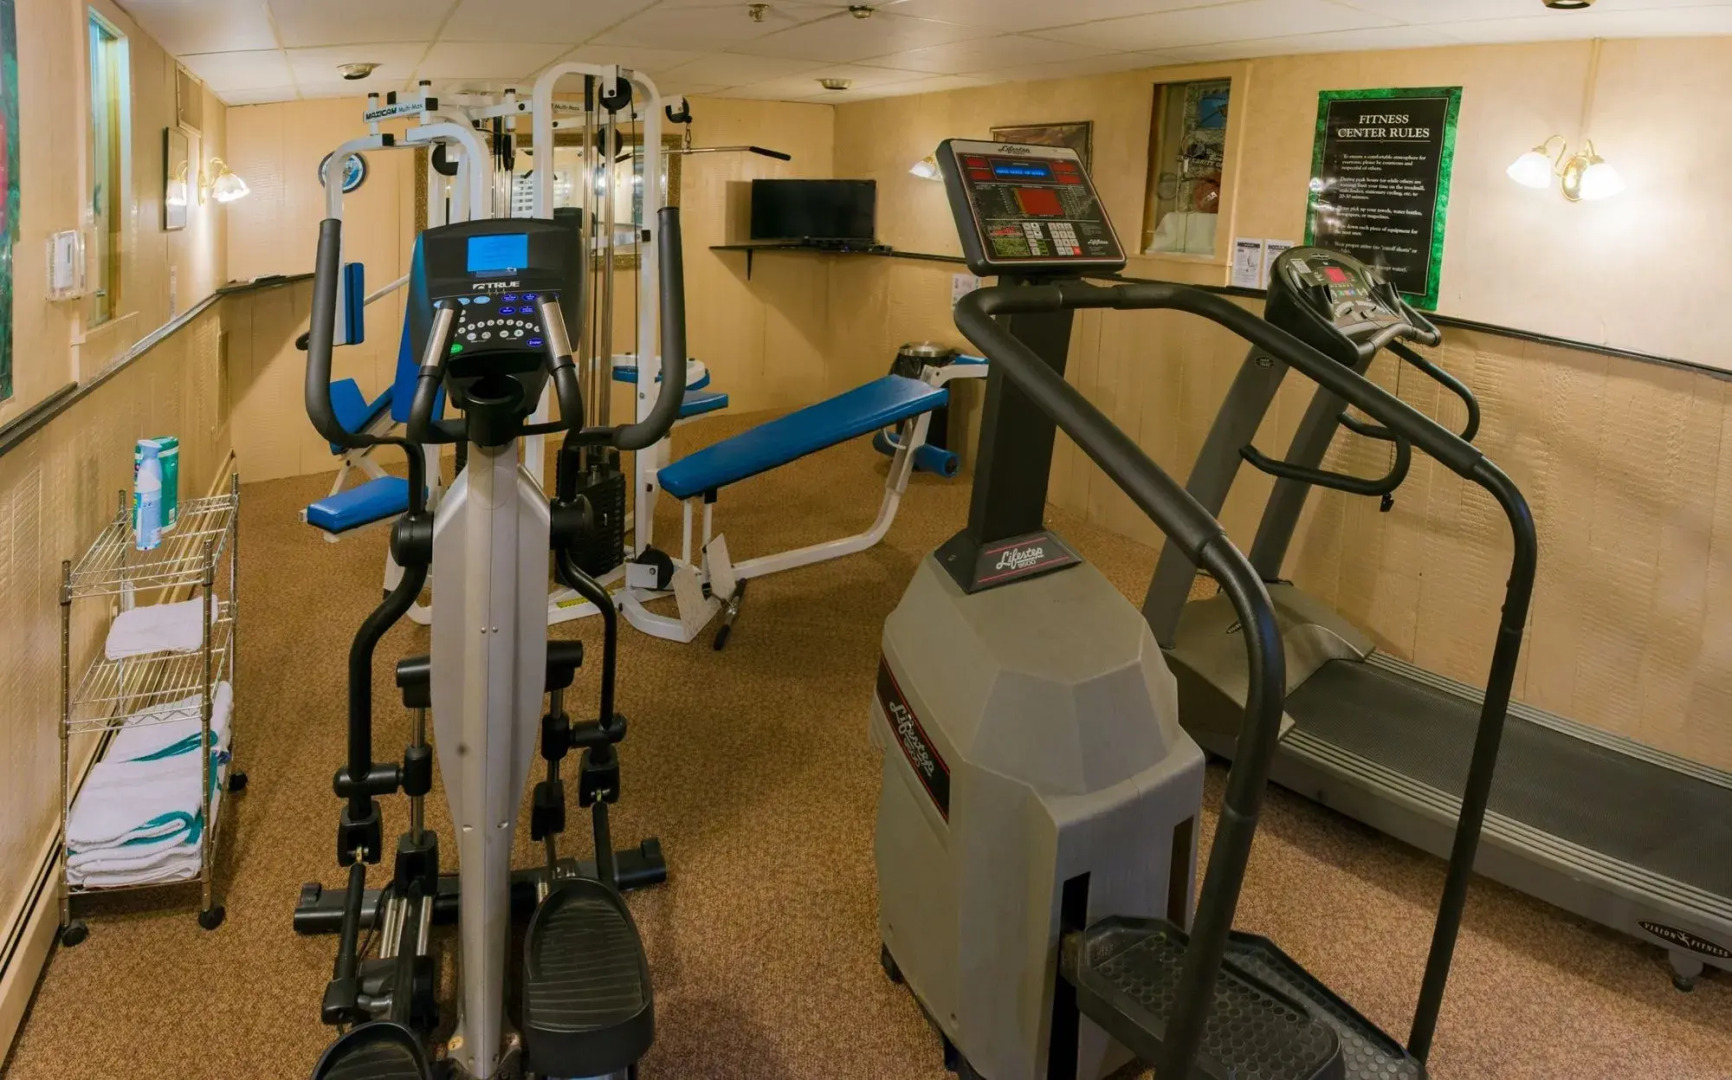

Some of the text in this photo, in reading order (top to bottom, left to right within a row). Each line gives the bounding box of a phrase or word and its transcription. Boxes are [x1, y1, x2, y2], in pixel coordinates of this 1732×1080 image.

[1359, 114, 1409, 124] FITNESS
[1338, 128, 1430, 138] CENTER RULES
[996, 547, 1044, 570] Lifestep
[889, 701, 934, 778] Lifestep
[1644, 922, 1729, 958] VISION FITNESS
